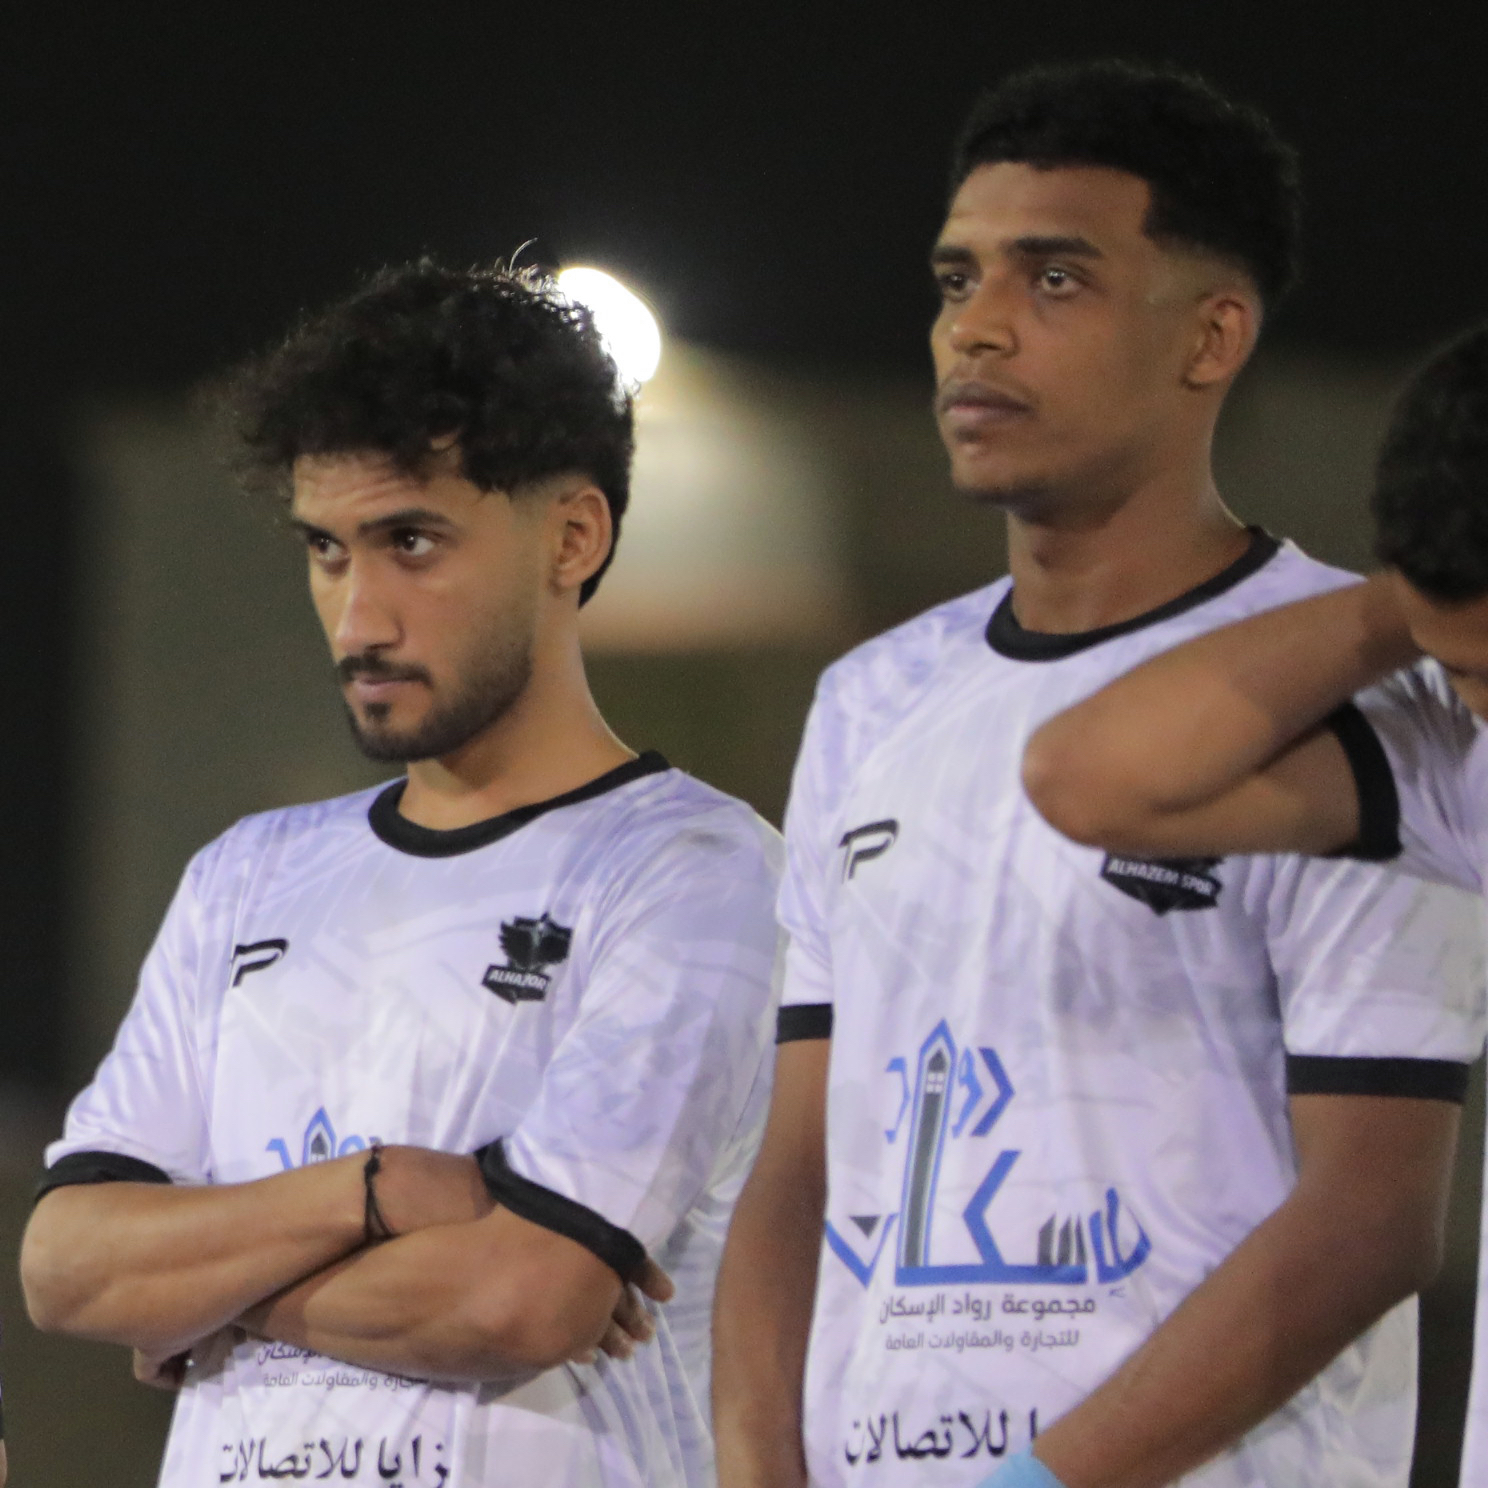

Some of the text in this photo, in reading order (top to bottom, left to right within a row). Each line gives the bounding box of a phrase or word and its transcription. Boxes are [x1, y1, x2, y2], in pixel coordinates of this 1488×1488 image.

[1181, 874, 1213, 896] SPOR
[952, 1292, 992, 1321] رواد
[1001, 1293, 1097, 1321] مجموعة
